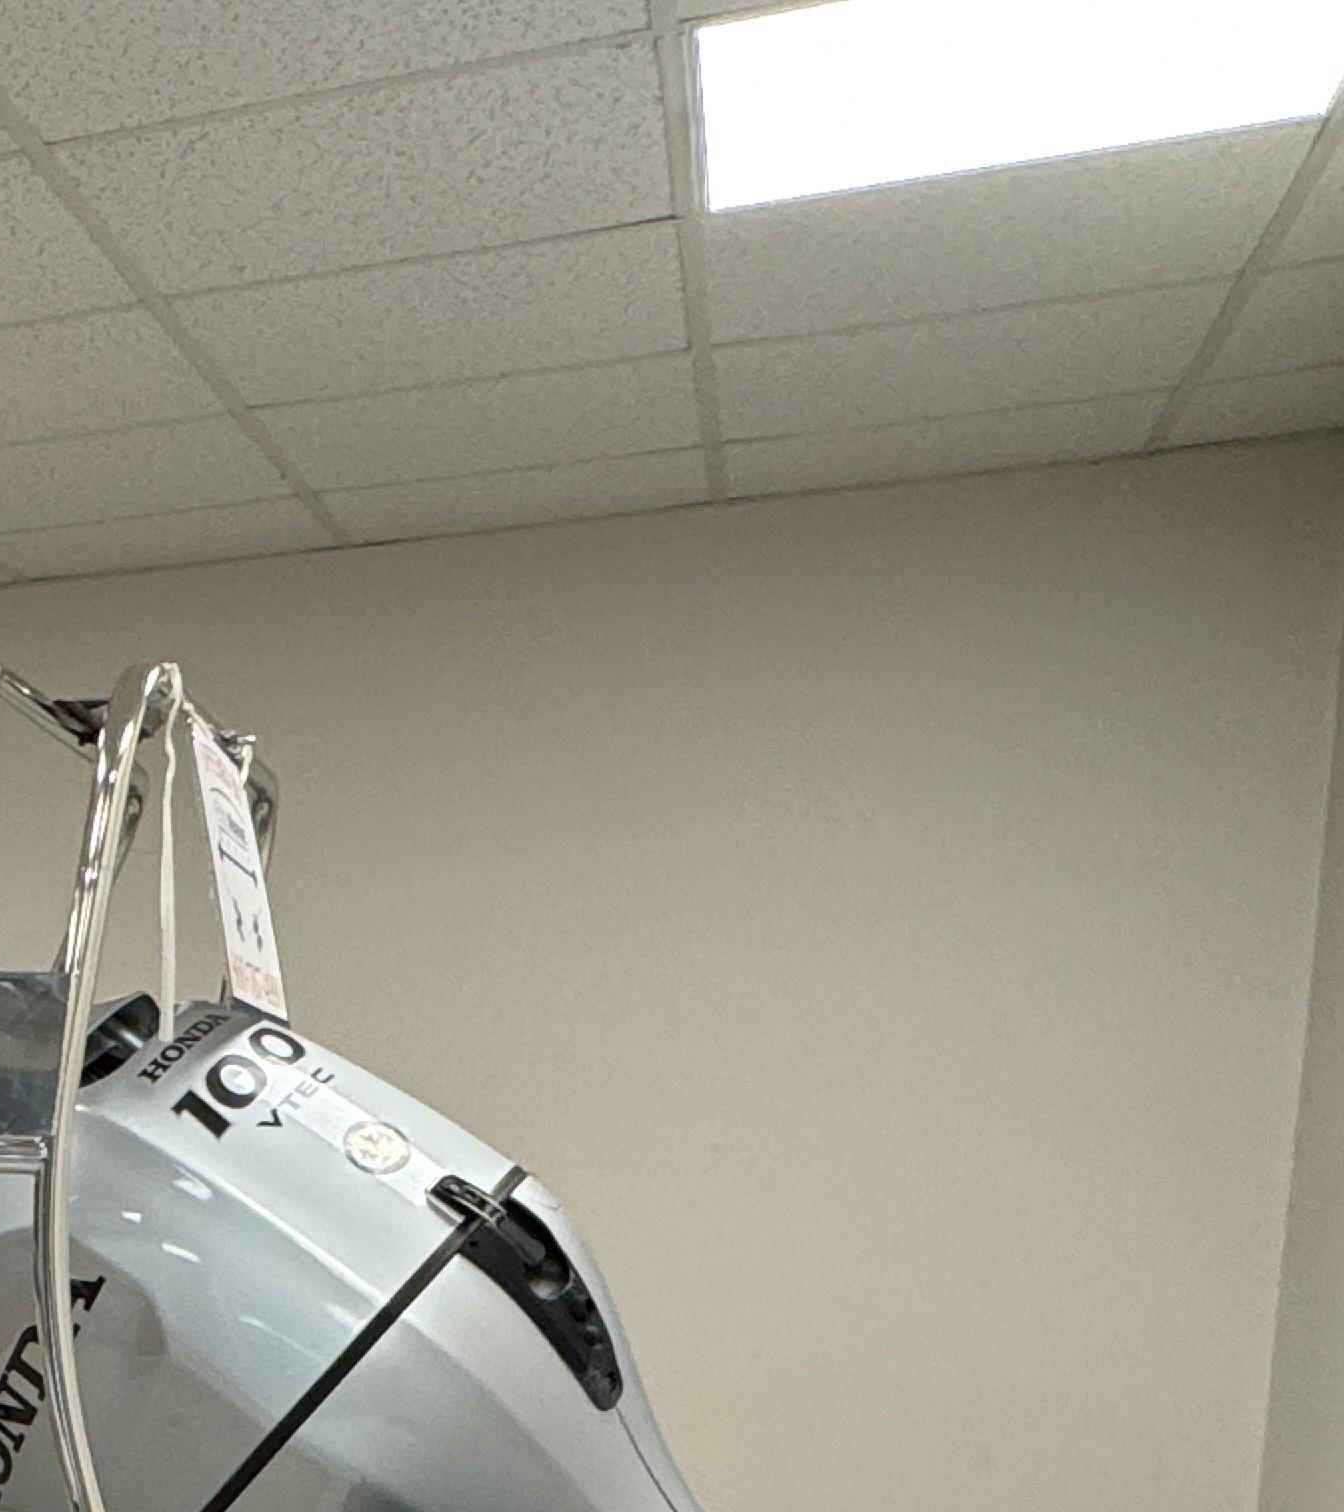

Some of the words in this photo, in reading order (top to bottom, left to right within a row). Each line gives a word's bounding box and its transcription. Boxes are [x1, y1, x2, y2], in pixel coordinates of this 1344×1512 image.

[138, 1013, 230, 1083] HONDA
[171, 1028, 306, 1141] 100
[257, 1066, 335, 1128] VTEC
